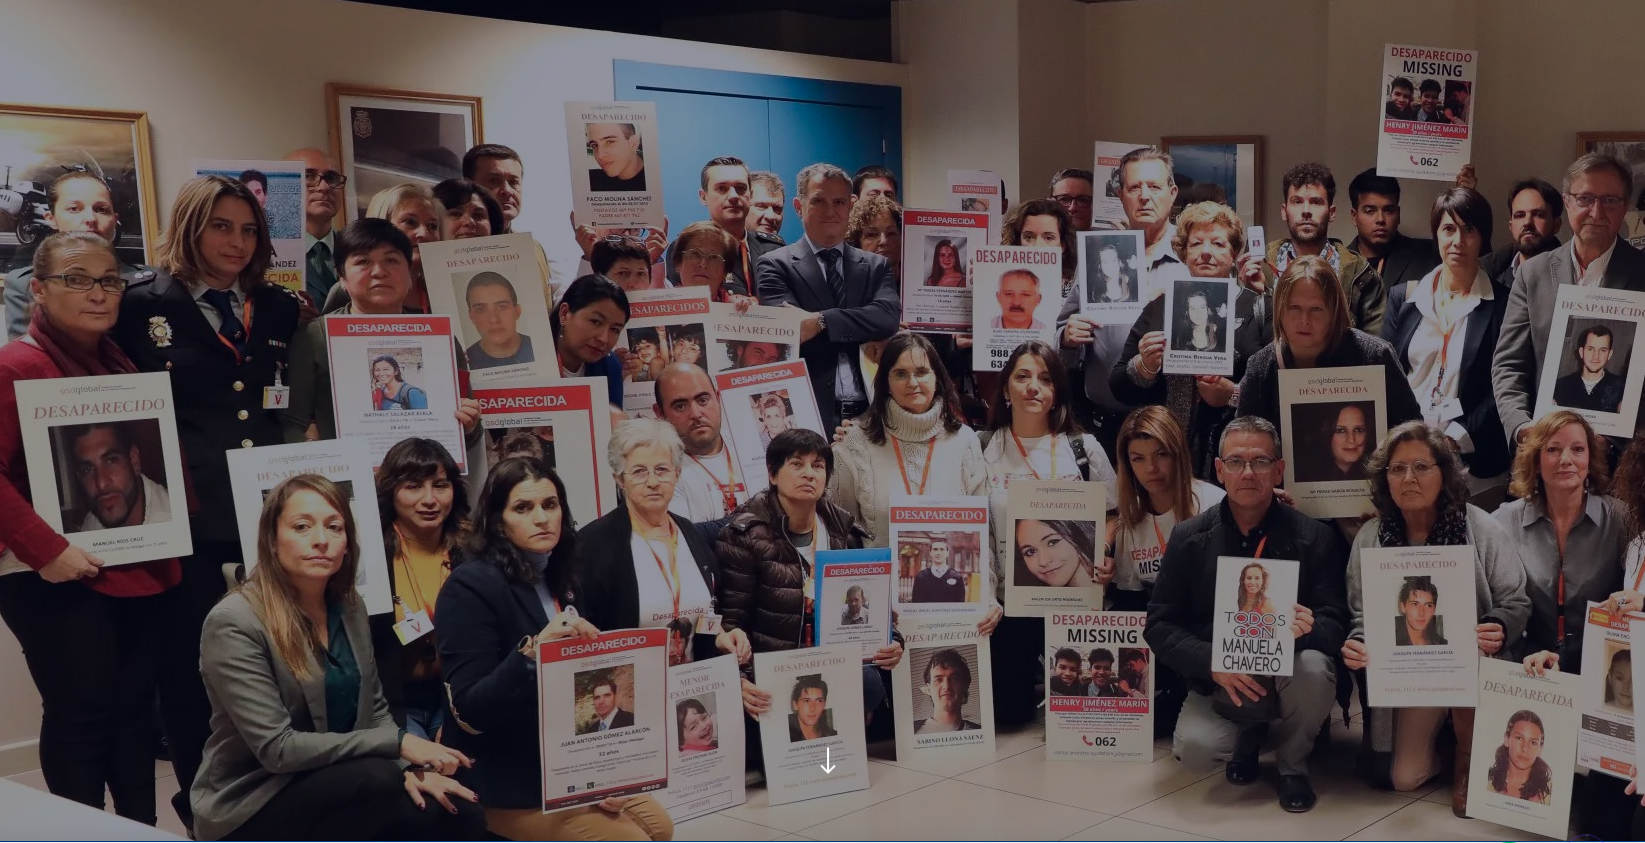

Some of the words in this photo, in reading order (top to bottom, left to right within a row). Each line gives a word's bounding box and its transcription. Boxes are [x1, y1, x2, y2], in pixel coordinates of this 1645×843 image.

[1391, 47, 1472, 62] DESAPARECIDO
[1403, 60, 1462, 77] MISSING
[1412, 122, 1440, 131] JIMÉNEZ
[1420, 158, 1438, 166] 062
[917, 216, 976, 225] DESAPARECIDA
[447, 253, 520, 268] DESAPARECIDO
[976, 250, 1057, 264] DESAPARECIDO
[630, 302, 706, 315] ESAPARECIDOS
[347, 324, 433, 333] DESAPARECIDA
[990, 349, 1008, 358] 988
[731, 369, 793, 385] DESAPARECIDA
[1299, 386, 1368, 395] DESAPARECIDA
[480, 395, 567, 409] SAPARECIDA
[34, 398, 165, 420] DESAPARECIDO
[895, 510, 983, 520] DESAPARECIDO
[830, 567, 885, 576] DESAPARECIDO
[1380, 560, 1457, 570] DESAPARECIDO
[1052, 614, 1147, 627] DESAPARECIDO
[1224, 612, 1286, 626] TODOS
[708, 621, 714, 631] V
[1234, 626, 1274, 639] CON
[905, 630, 980, 643] DESAPARECIDO
[1068, 628, 1137, 643] MISSING
[561, 636, 647, 657] DESAPARECIDO
[1222, 637, 1283, 655] MANUELA
[774, 658, 846, 673] DESAPARECIDO
[1223, 655, 1281, 672] CHAVERO
[680, 674, 709, 687] MENOR
[670, 682, 725, 699] ESAPARECIDA
[1484, 681, 1573, 707] DESAPARECIDA
[1082, 698, 1116, 707] JIMÉNEZ
[560, 739, 575, 748] JUAN
[577, 735, 602, 744] ANTONIO
[1095, 737, 1116, 746] 062
